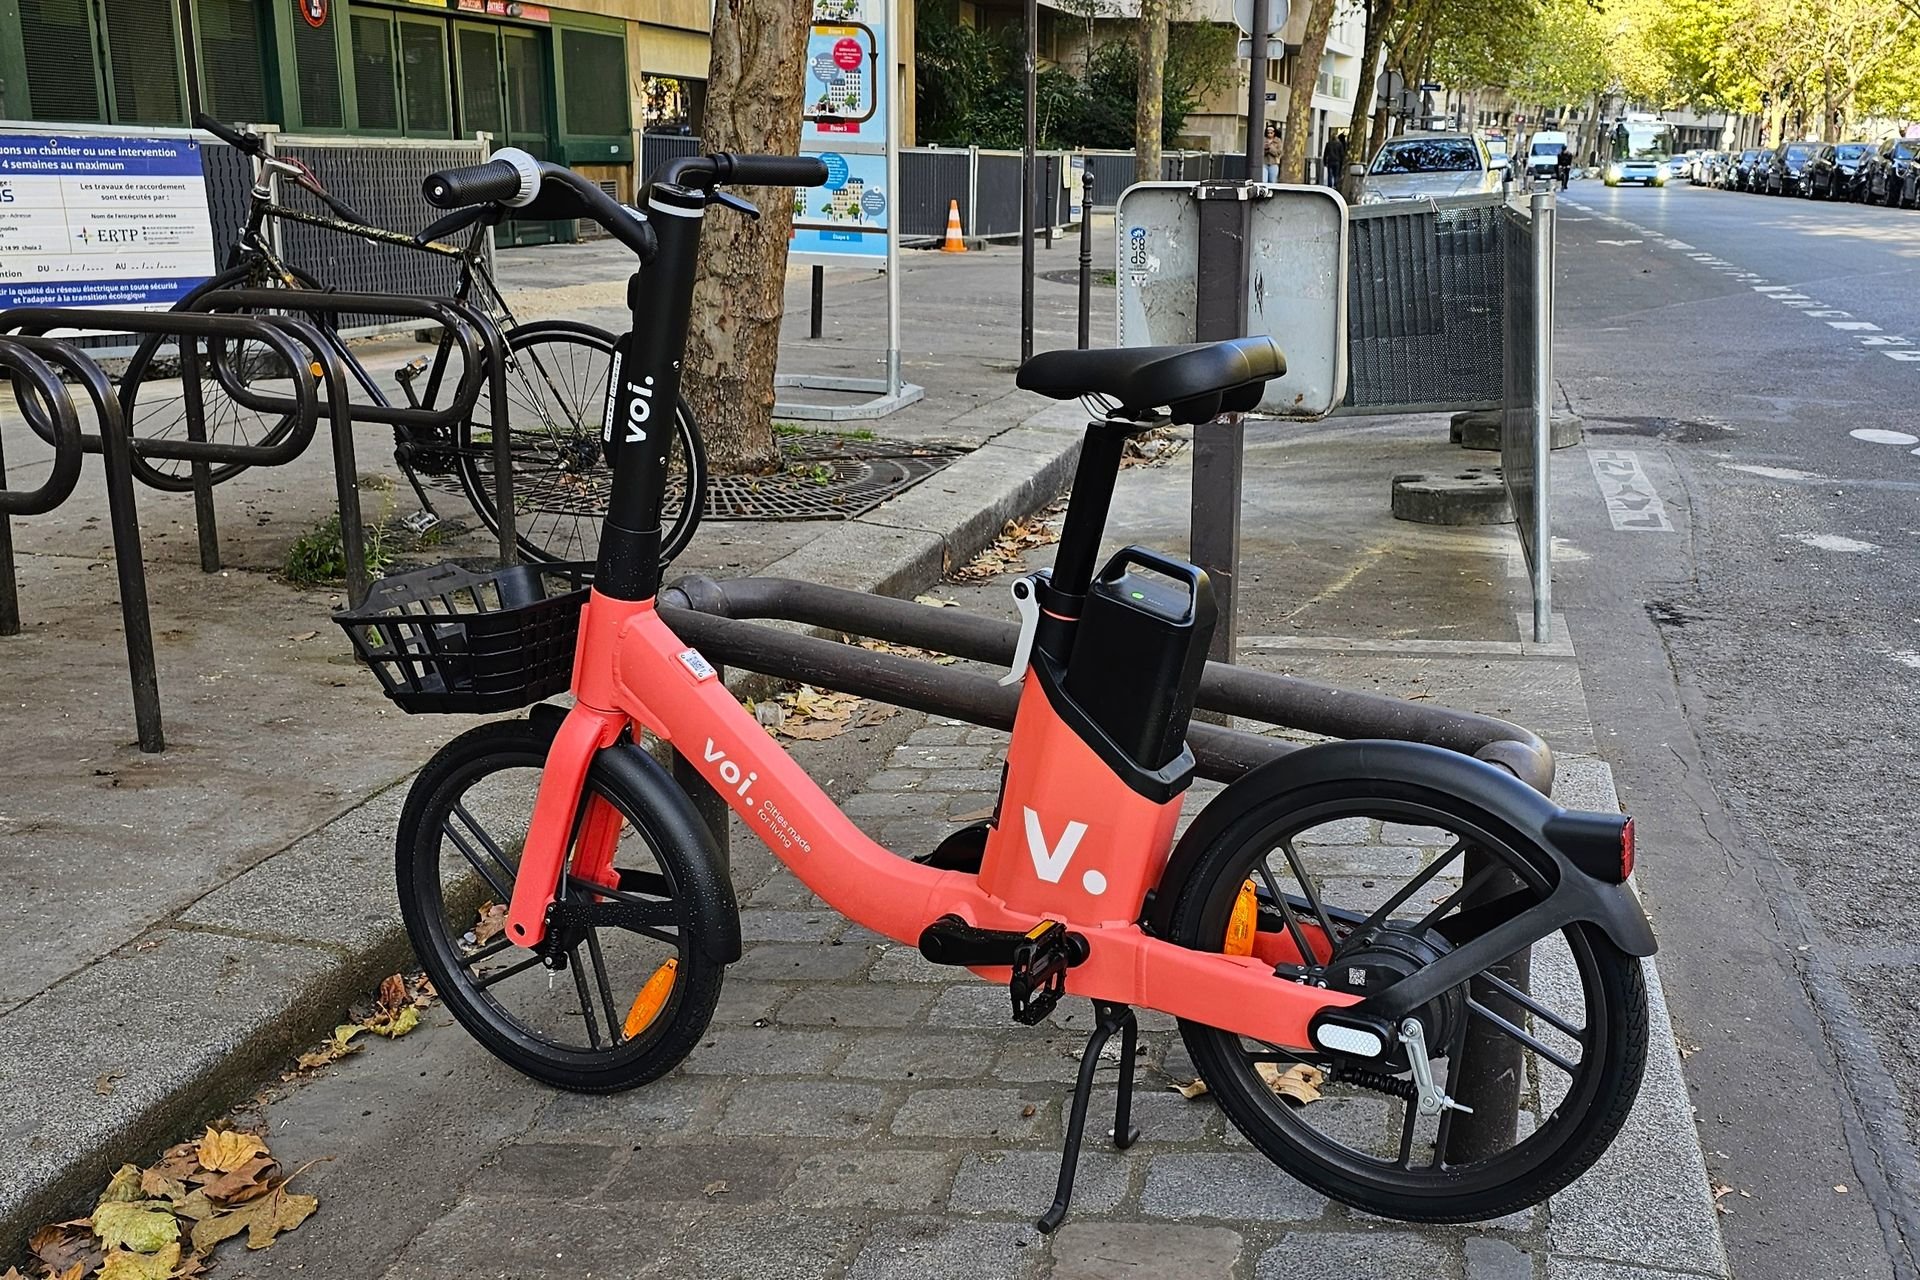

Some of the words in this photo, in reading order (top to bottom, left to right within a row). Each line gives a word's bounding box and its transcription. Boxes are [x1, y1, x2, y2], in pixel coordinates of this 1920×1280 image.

[39, 145, 81, 155] chantier
[98, 148, 116, 156] une
[118, 147, 176, 157] intervention
[2, 160, 9, 169] 4
[11, 160, 59, 169] semaines
[75, 160, 125, 170] maximum
[97, 229, 138, 242] ERTP
[1131, 237, 1146, 251] 83
[1130, 251, 1146, 265] SP
[9, 287, 17, 295] la
[18, 286, 44, 296] qualité
[45, 286, 55, 294] du
[56, 285, 81, 293] réseau
[83, 284, 119, 294] électrique
[150, 282, 178, 290] sécurité
[13, 295, 21, 304] et
[22, 295, 56, 304] l'adapter
[57, 294, 63, 302] à
[63, 294, 71, 302] la
[72, 292, 107, 301] transition
[108, 292, 146, 301] écologique
[625, 376, 654, 443] voi.
[703, 737, 758, 806] voi.
[757, 808, 771, 823] for
[769, 820, 792, 848] living
[763, 800, 789, 828] Cities
[787, 826, 811, 853] made
